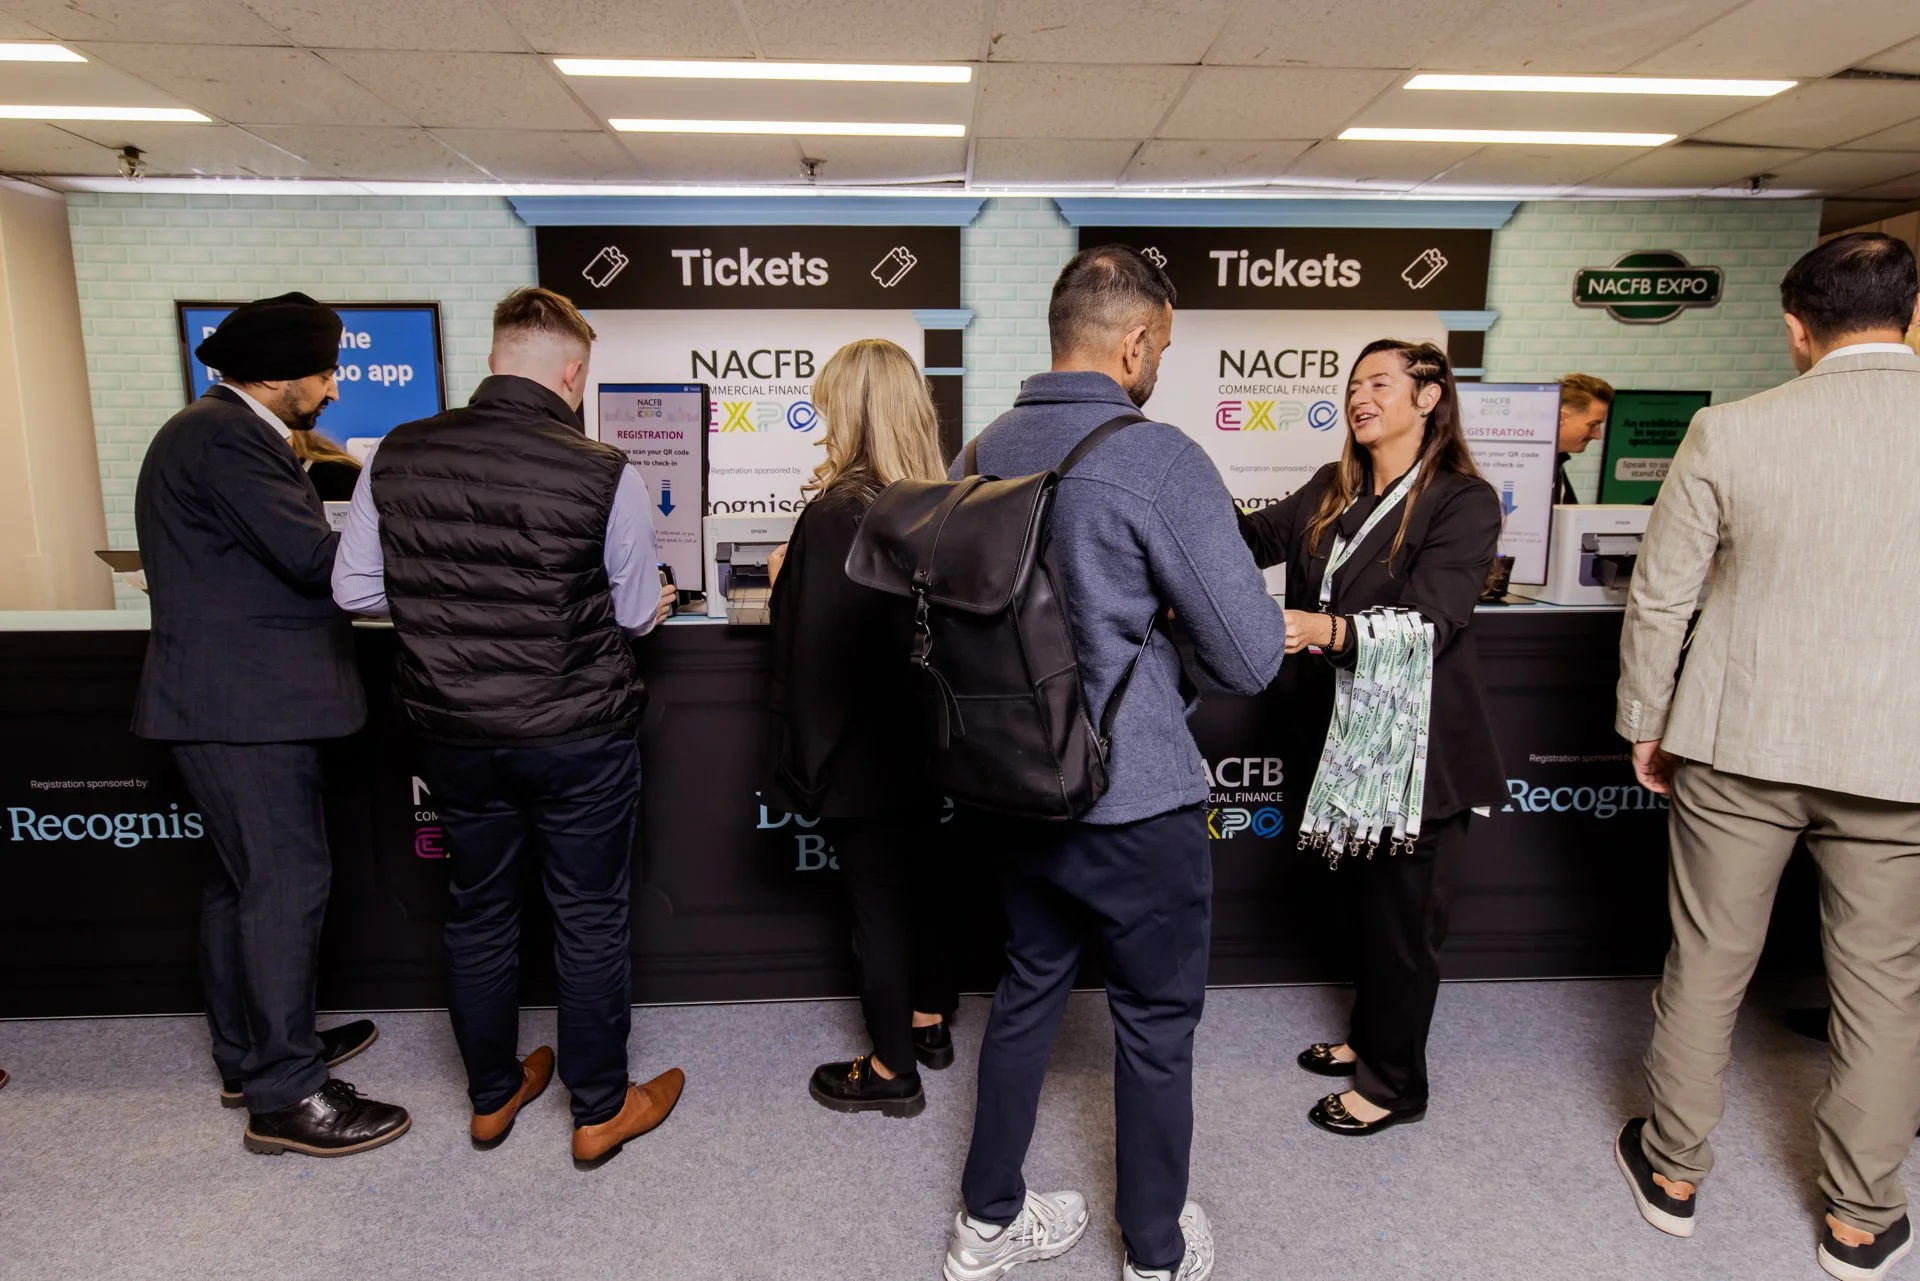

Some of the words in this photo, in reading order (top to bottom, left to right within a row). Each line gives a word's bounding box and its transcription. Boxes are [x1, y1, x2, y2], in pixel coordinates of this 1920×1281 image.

[671, 247, 829, 287] Tickets
[1209, 248, 1362, 288] Tickets
[1588, 278, 1651, 295] NACFB
[1656, 277, 1708, 295] EXPO
[691, 349, 815, 379] NACFB
[1219, 349, 1339, 379] NACFB
[368, 363, 413, 387] app
[1218, 384, 1289, 395] COMMERCIAL
[1292, 384, 1338, 395] FINANCE
[637, 398, 662, 407] NACFB
[1216, 400, 1338, 431] EXPO
[617, 430, 684, 440] REGISTRATION
[651, 459, 678, 467] check-in
[1230, 464, 1271, 473] Registration
[1622, 460, 1646, 470] Speak
[1649, 461, 1658, 469] to
[710, 466, 753, 475] Registration
[754, 466, 791, 475] sponsored
[1529, 754, 1581, 764] Registration
[1582, 753, 1623, 764] sponsored
[31, 779, 85, 791] Registration
[86, 779, 135, 789] sponsored
[1235, 792, 1283, 803] FINANCE
